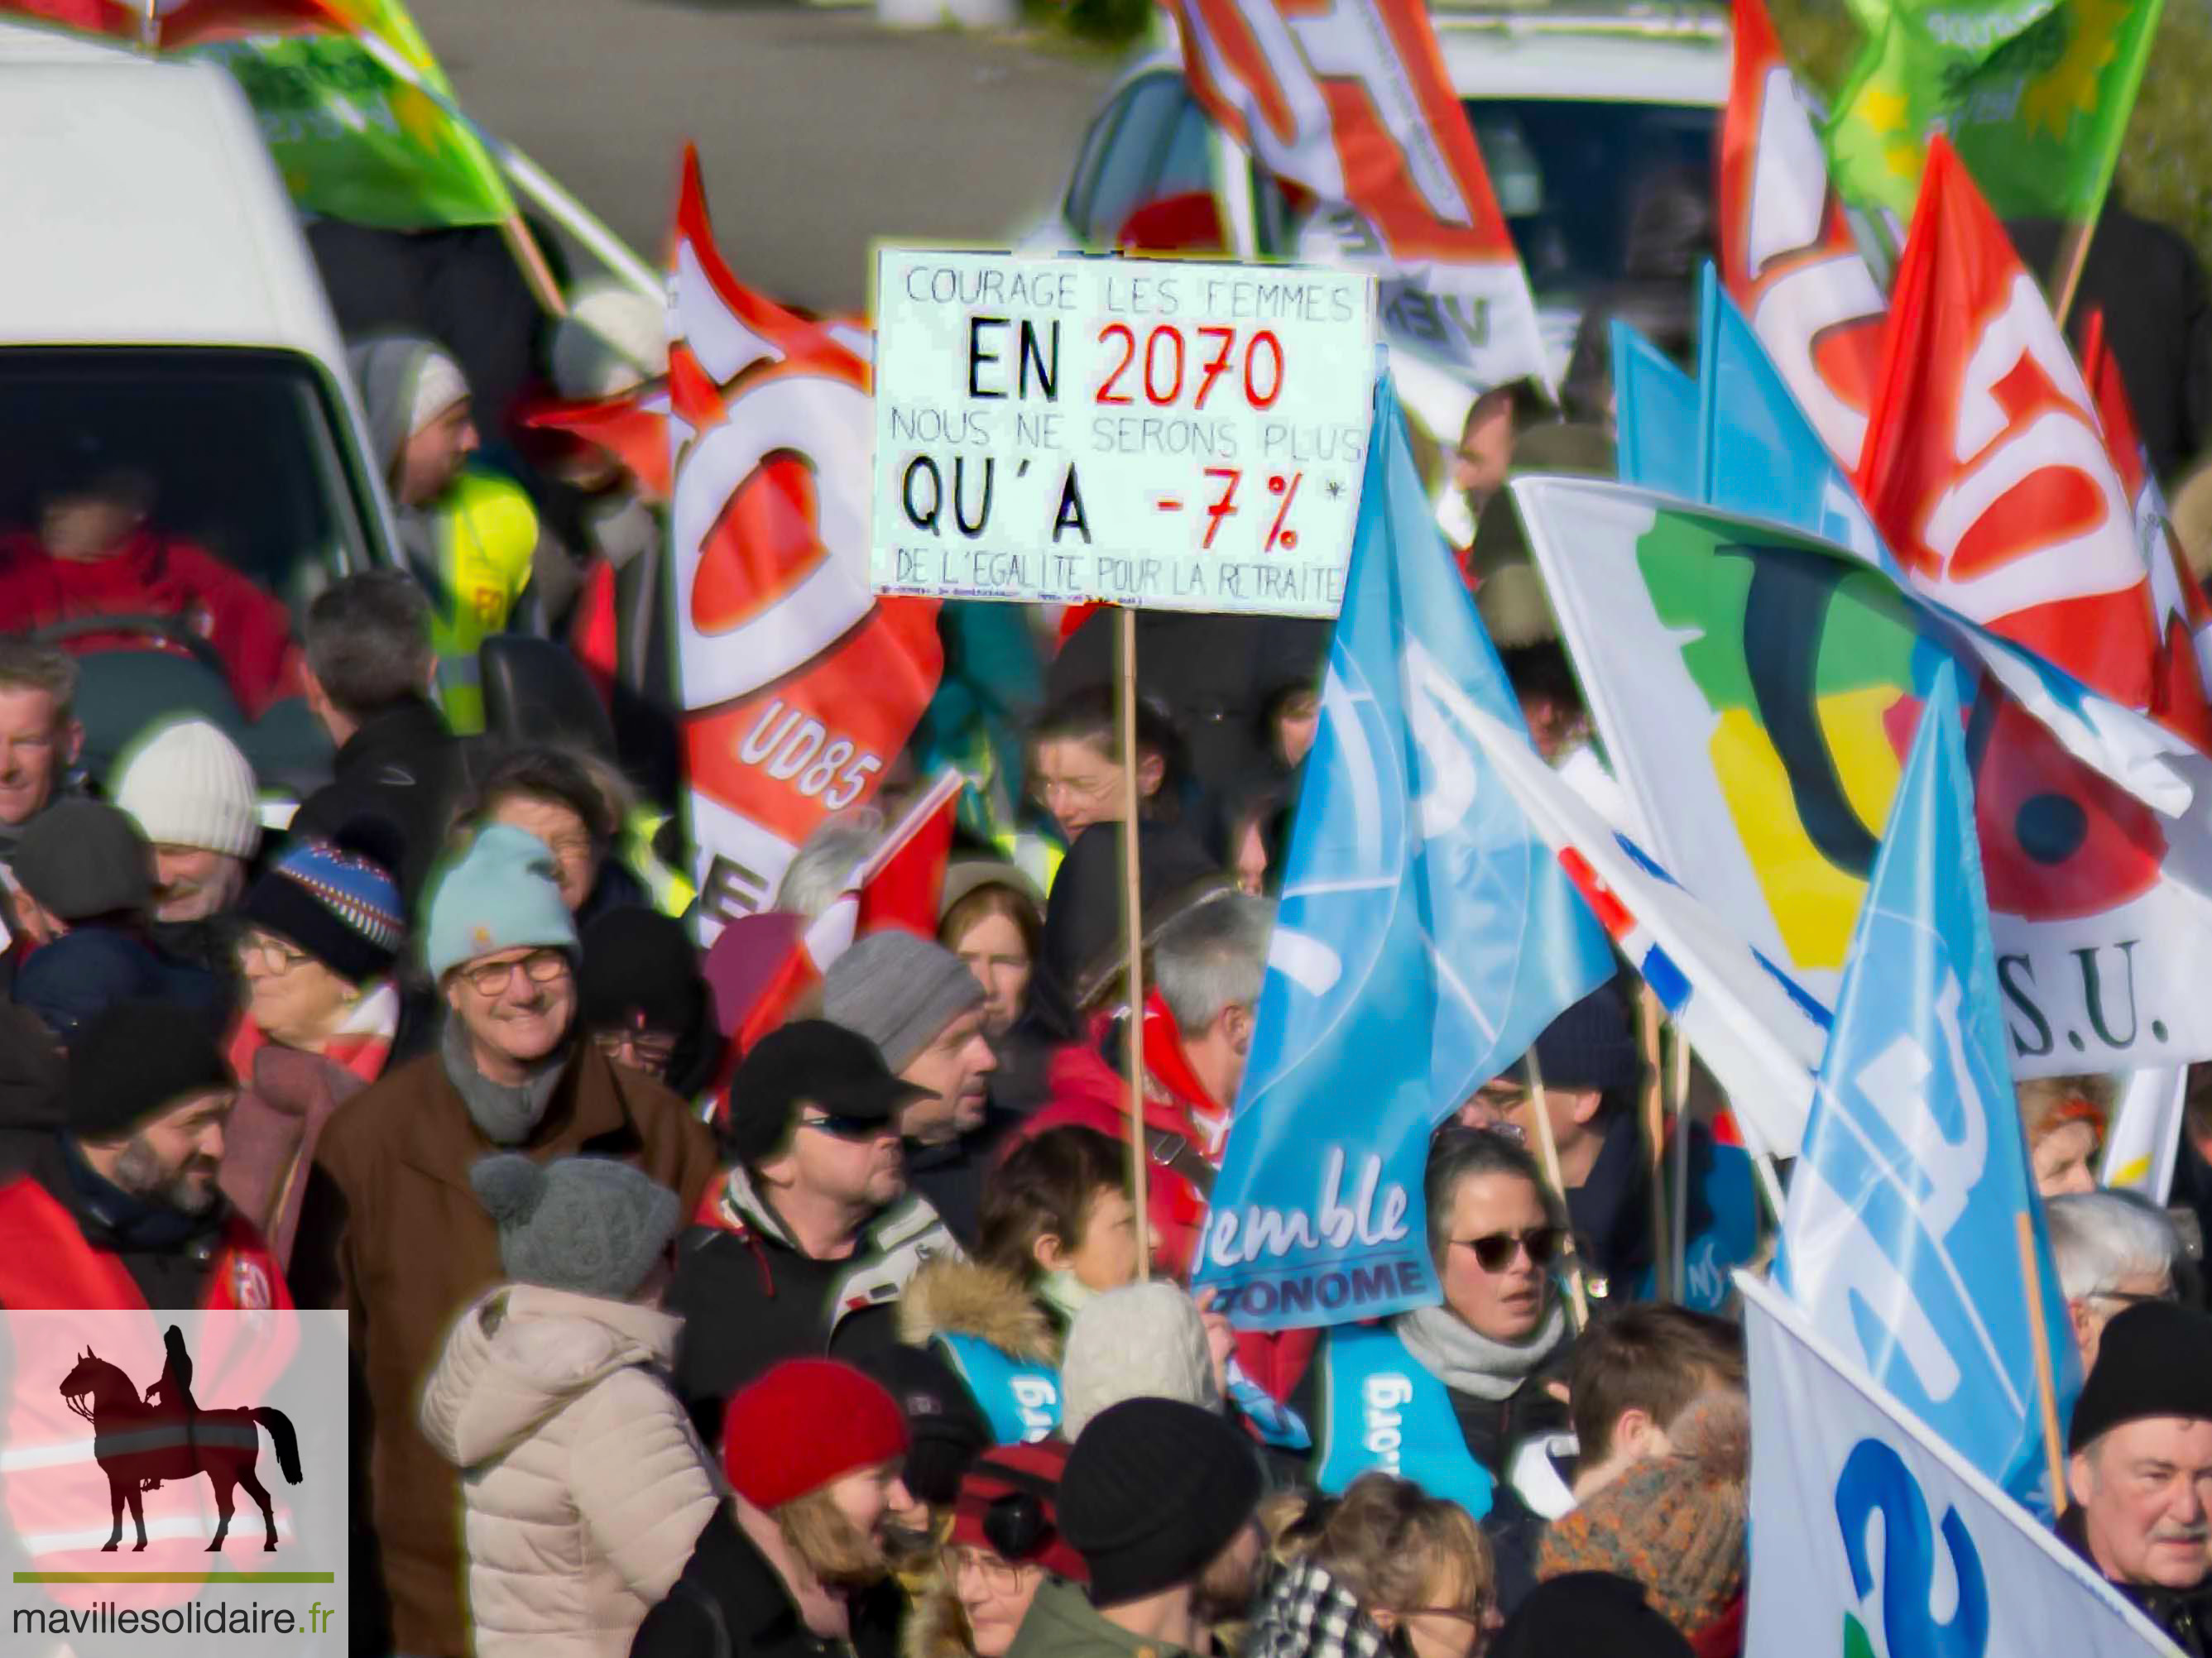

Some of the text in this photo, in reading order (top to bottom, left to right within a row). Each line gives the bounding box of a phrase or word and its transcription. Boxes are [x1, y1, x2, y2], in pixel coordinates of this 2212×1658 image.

[907, 266, 1353, 323] COURAGE LES FEMMES
[968, 316, 1285, 411] EN 2070
[890, 406, 1365, 462] NOUS NE SERONS PLUS
[896, 548, 928, 582] DE
[1097, 556, 1163, 593] POUR
[1173, 561, 1207, 596] LA
[1217, 563, 1346, 602] RETRAITE
[741, 701, 882, 810] UD85
